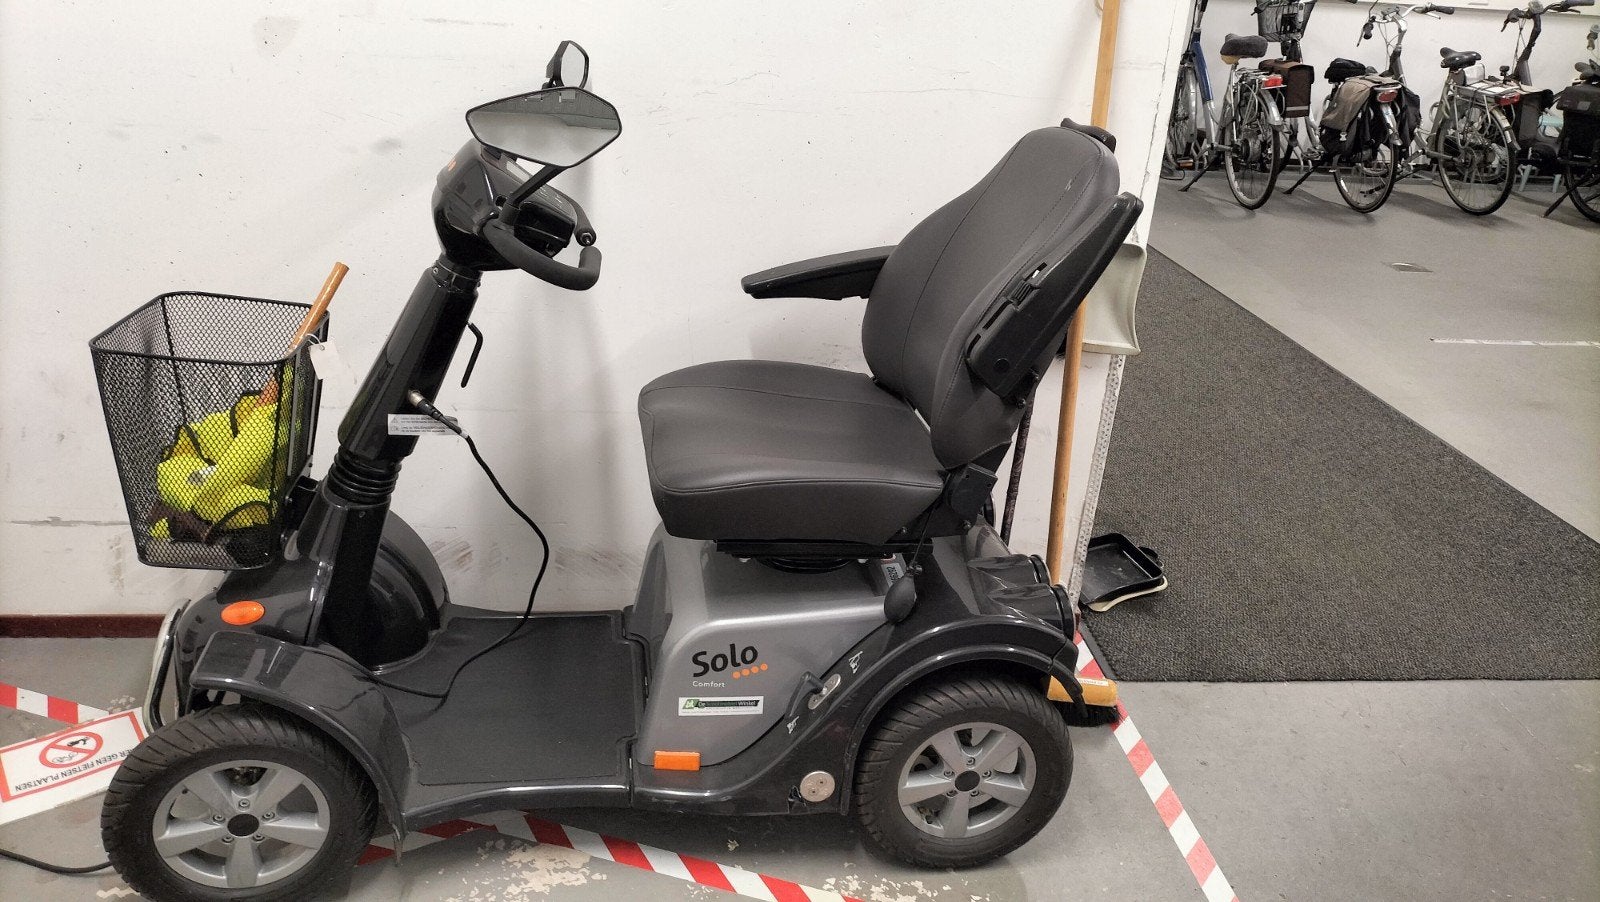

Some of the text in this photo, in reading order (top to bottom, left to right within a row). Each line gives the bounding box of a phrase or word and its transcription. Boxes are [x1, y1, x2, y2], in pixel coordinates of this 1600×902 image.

[692, 643, 758, 677] Solo
[96, 753, 118, 766] GEEN
[61, 762, 95, 778] FIETSEN
[15, 775, 59, 791] PLAATSEN
